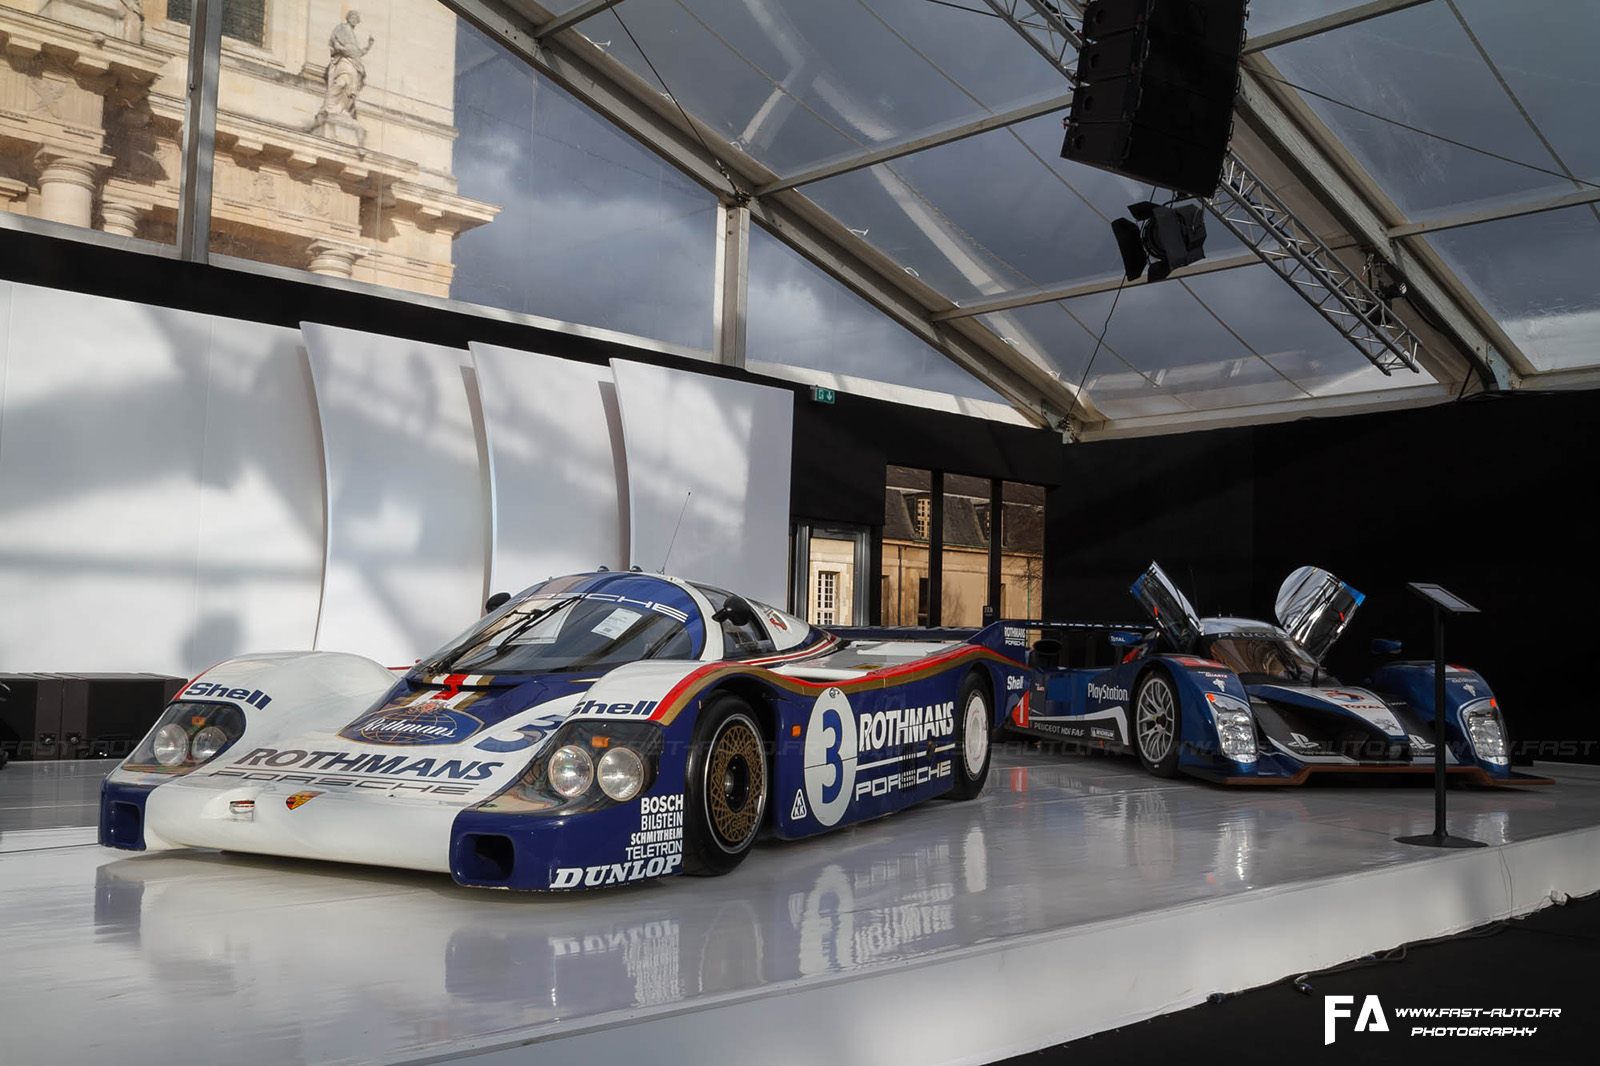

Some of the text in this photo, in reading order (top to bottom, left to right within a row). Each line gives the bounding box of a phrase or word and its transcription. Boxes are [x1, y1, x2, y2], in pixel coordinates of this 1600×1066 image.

[1007, 676, 1024, 690] Shell
[1088, 683, 1128, 704] PlayStation
[185, 683, 272, 711] Shell
[571, 700, 658, 717] Shell
[355, 718, 458, 738] Rothmans
[858, 701, 954, 752] ROTHMANS
[1034, 722, 1060, 733] PEUGEOT
[233, 748, 503, 780] ROTHMANS
[822, 709, 844, 804] 3
[208, 770, 475, 795] PORSCHE
[855, 760, 951, 802] PORSCHE
[641, 794, 684, 815] BOSCH
[641, 811, 683, 831] BILSTEIN
[625, 840, 683, 860] TELETRON
[550, 854, 682, 888] DUNLOP
